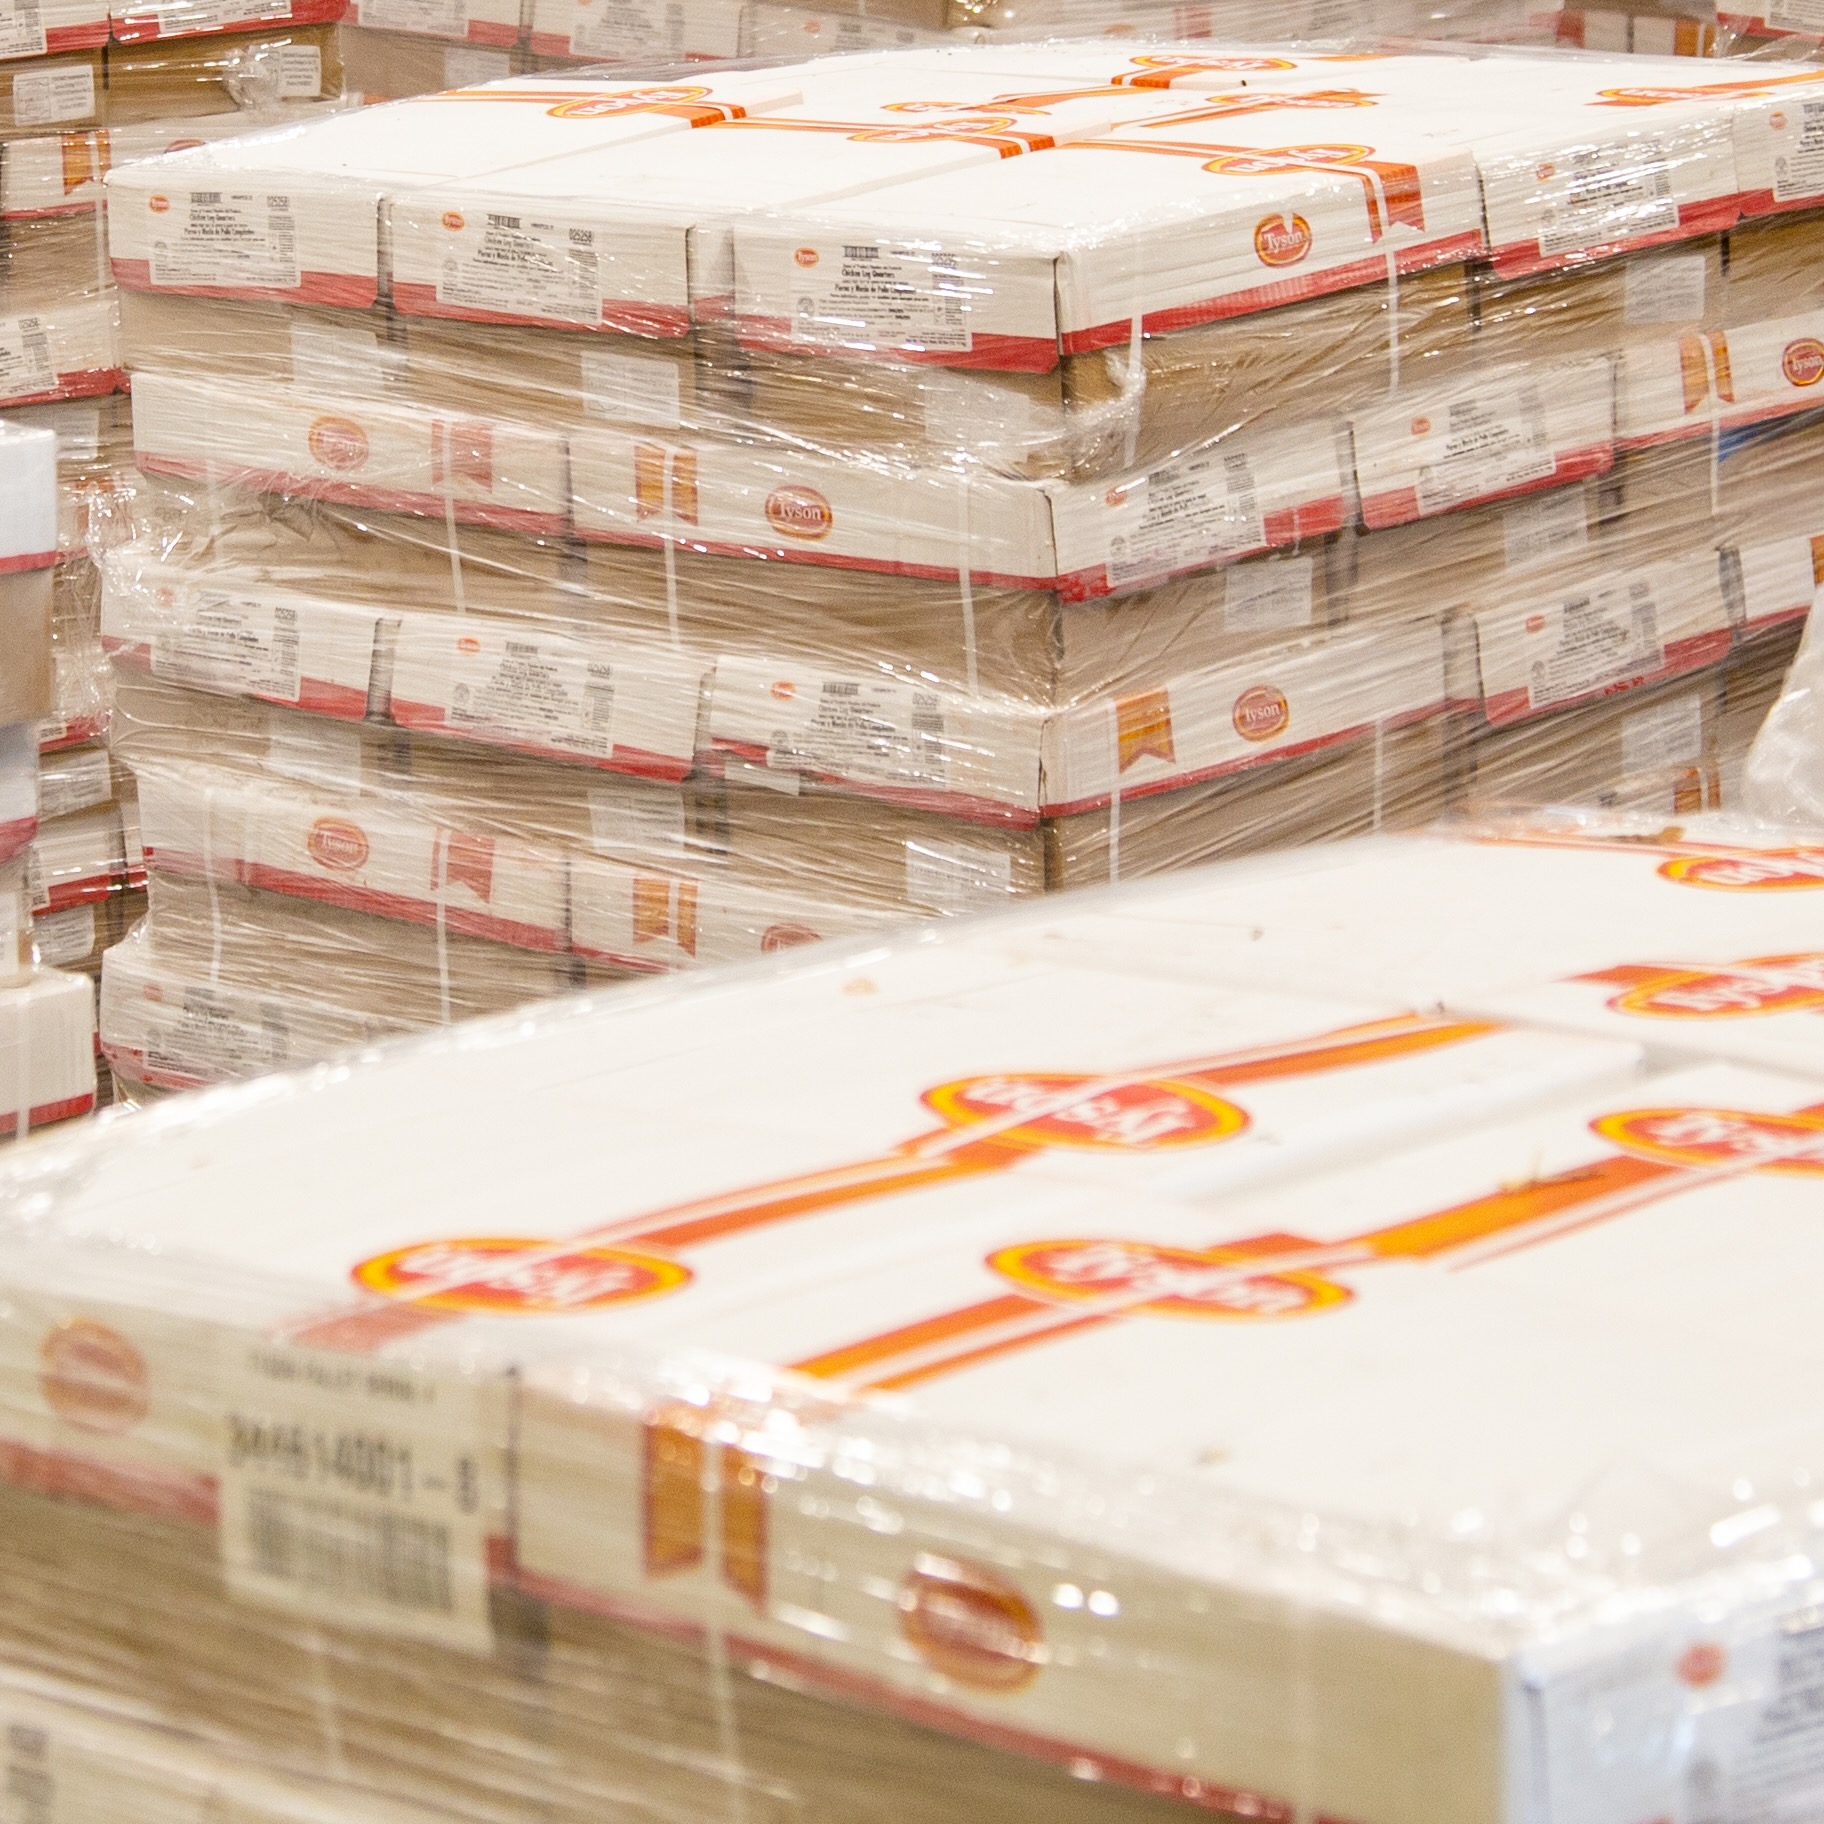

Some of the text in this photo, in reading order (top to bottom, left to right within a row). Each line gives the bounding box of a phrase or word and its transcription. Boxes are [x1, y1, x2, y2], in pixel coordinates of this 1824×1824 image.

[1222, 149, 1350, 173] Tyson
[1266, 228, 1304, 251] Tyson
[1792, 354, 1824, 376] Tyson
[778, 505, 824, 526] Tyson
[1247, 704, 1282, 723] Tyson
